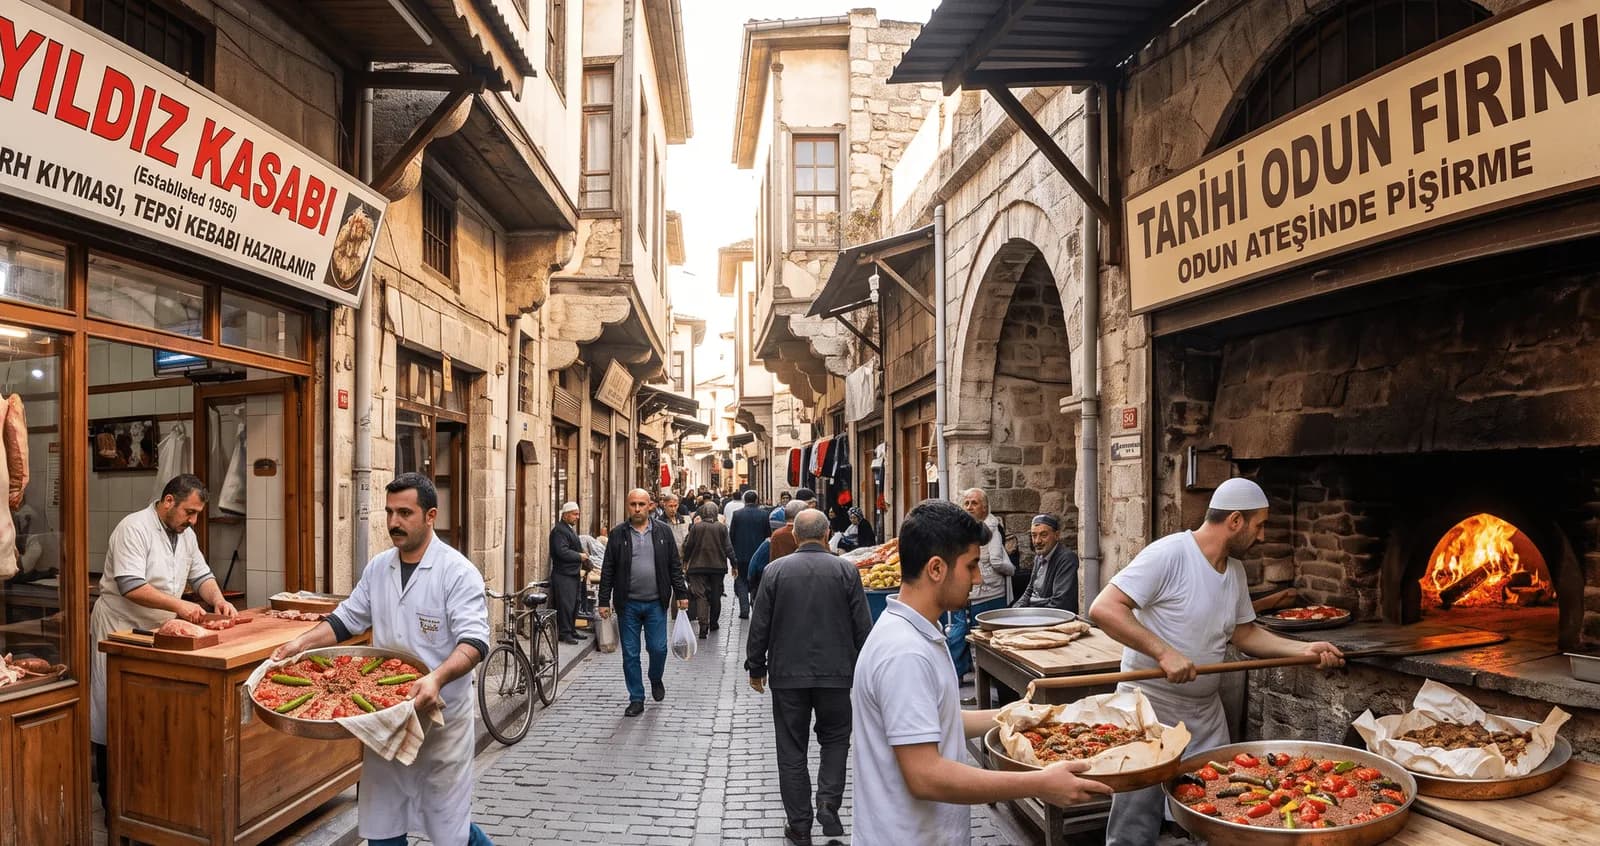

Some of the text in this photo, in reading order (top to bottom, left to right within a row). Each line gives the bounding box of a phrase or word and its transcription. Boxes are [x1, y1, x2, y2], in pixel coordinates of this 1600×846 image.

[0, 15, 338, 237] YILDIZ KASABI
[1137, 148, 1249, 259] TARİHİ
[1261, 98, 1392, 209] ODUN
[36, 160, 125, 217] KIYMASI,
[134, 193, 183, 232] TEPSİ
[184, 213, 240, 252] KEBABI
[243, 236, 317, 281] HAZIRLANIR
[209, 196, 237, 223] 1956)
[1178, 140, 1534, 284] ODUN ATEŞİNDE PİŞİRME
[1124, 412, 1134, 423] 50
